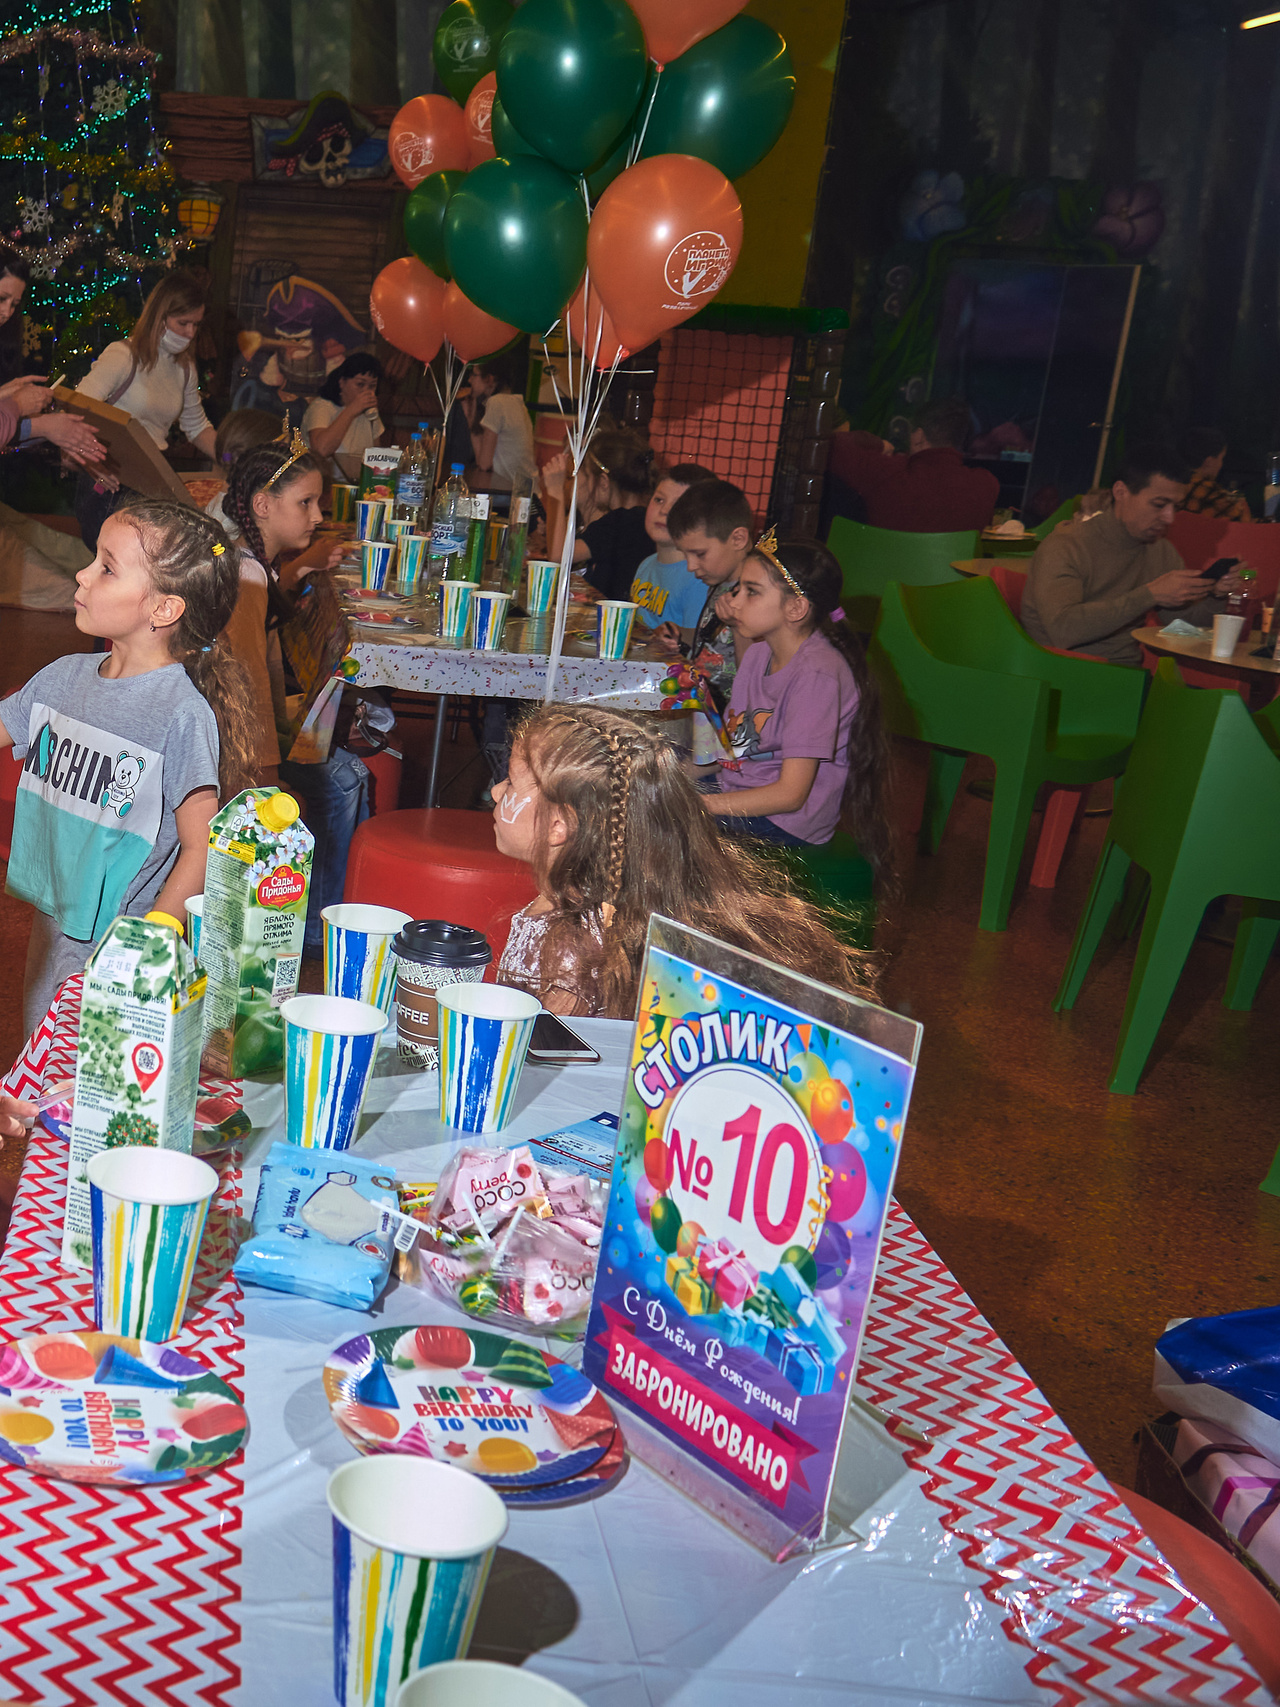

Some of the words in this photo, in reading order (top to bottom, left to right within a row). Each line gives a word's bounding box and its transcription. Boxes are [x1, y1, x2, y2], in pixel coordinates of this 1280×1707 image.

[261, 884, 302, 899] Придонья
[270, 876, 294, 888] Сады
[263, 913, 296, 925] ЯБЛОКО
[263, 921, 295, 932] ПРЯМОГО
[263, 929, 293, 940] ОТЖИМА
[90, 982, 102, 991] МЫ
[107, 987, 126, 996] САДЫ
[128, 991, 167, 1005] ПРИДОНЬЯ!
[633, 1010, 794, 1109] СТОЛИК
[470, 1172, 508, 1194] berry
[722, 1104, 809, 1245] 10
[624, 1287, 640, 1315] С
[646, 1299, 697, 1356] Днём
[704, 1338, 802, 1426] Рождения!
[417, 1385, 514, 1404] HAPPY
[60, 1398, 84, 1412] TO
[111, 1398, 150, 1454] HAPPY
[434, 1417, 465, 1432] TO
[471, 1418, 529, 1433] YOU!
[611, 1343, 787, 1491] ЗАБРОНИРОВАНО
[63, 1417, 91, 1449] YOU!
